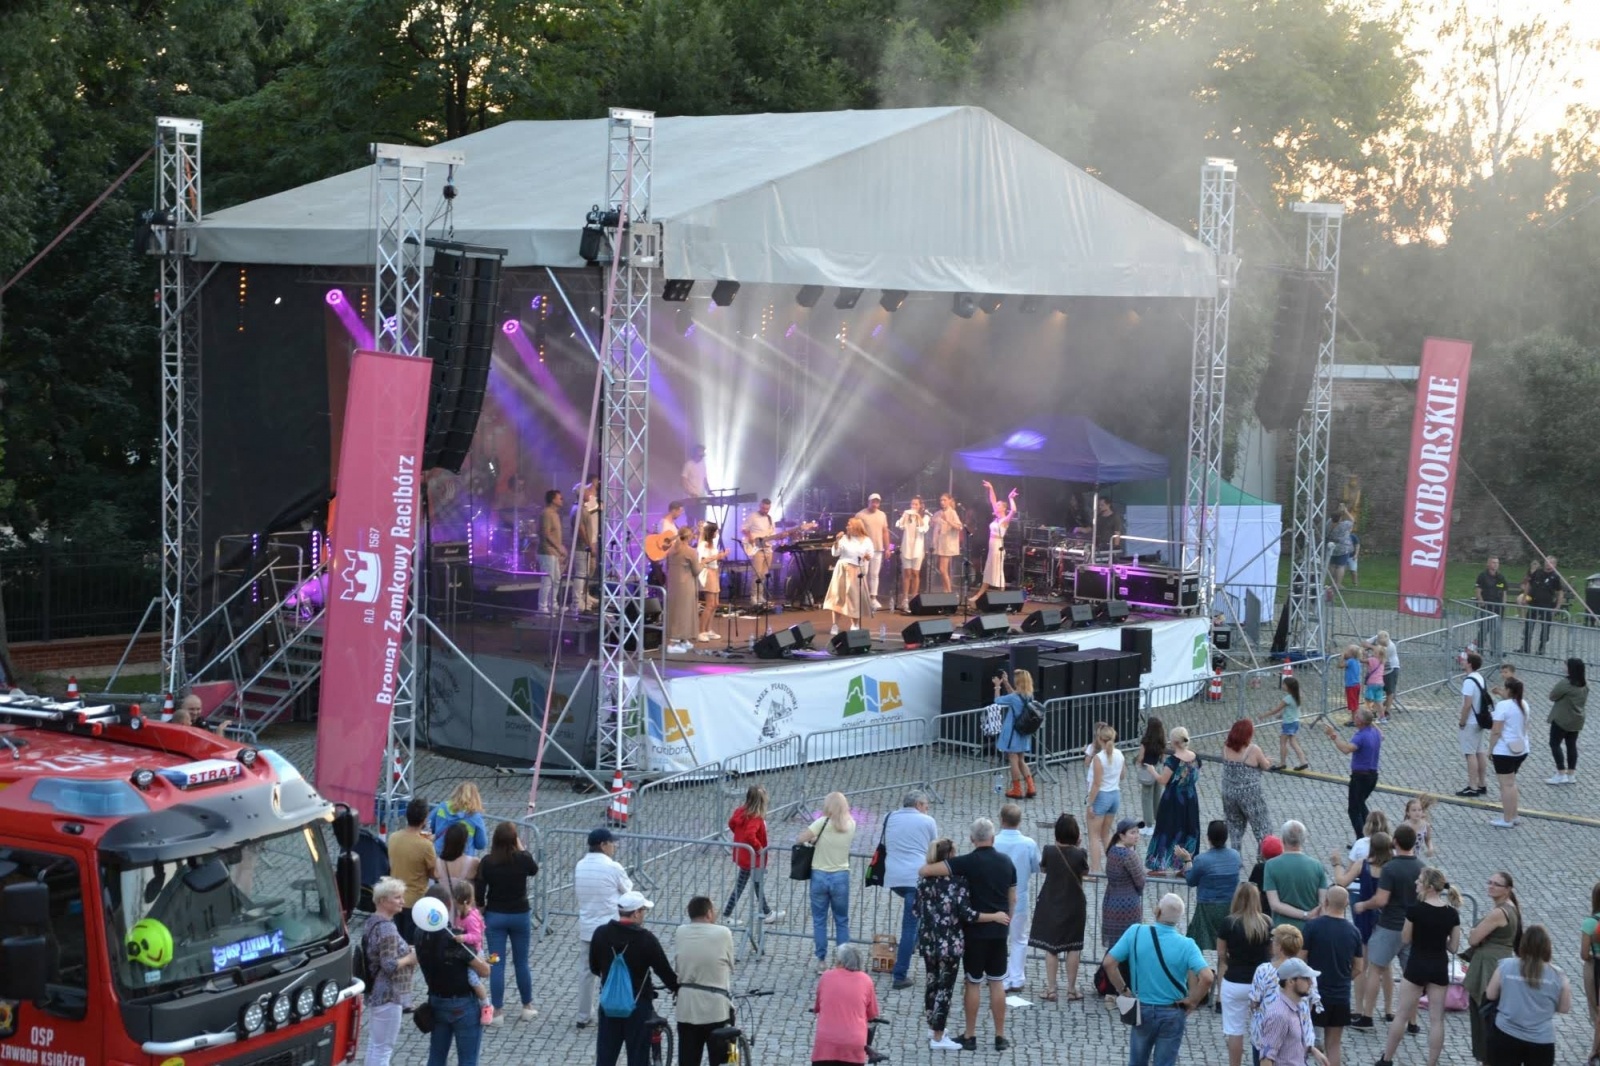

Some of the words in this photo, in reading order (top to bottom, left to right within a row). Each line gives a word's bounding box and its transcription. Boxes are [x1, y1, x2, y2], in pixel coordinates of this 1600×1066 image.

[1411, 375, 1460, 570] RACIBORSKIE
[390, 455, 415, 538] Racibórz
[368, 527, 380, 548] 1567
[384, 543, 407, 633] Zamkowy
[376, 638, 397, 705] Browar
[651, 741, 696, 756] raciborsi
[1, 1044, 38, 1064] ZAWADA
[31, 1026, 54, 1047] OSP
